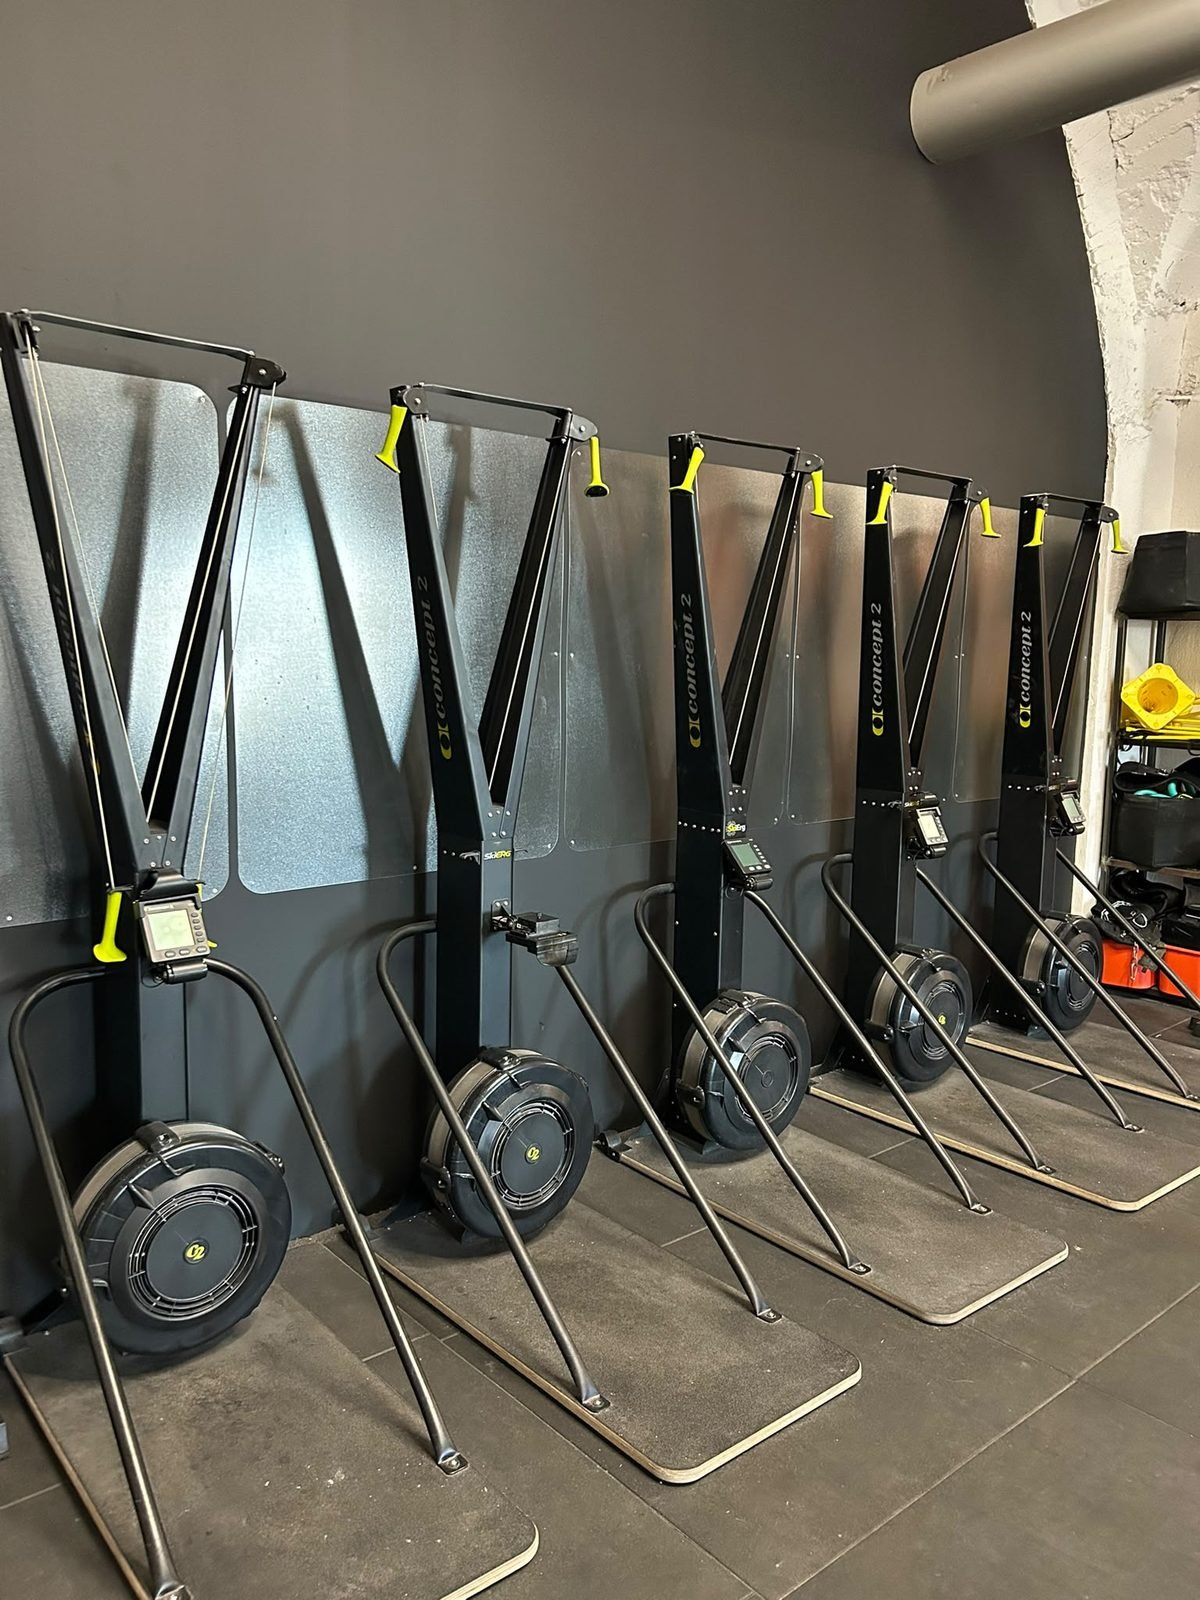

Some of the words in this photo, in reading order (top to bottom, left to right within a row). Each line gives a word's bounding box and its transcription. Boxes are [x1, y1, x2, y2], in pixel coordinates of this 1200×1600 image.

[417, 575, 428, 591] 2
[681, 593, 692, 607] 2
[871, 602, 882, 615] 2
[1020, 611, 1032, 622] 2
[420, 600, 447, 720] concept
[682, 612, 699, 714] concept
[872, 619, 884, 707] concept
[1020, 625, 1033, 702] concept
